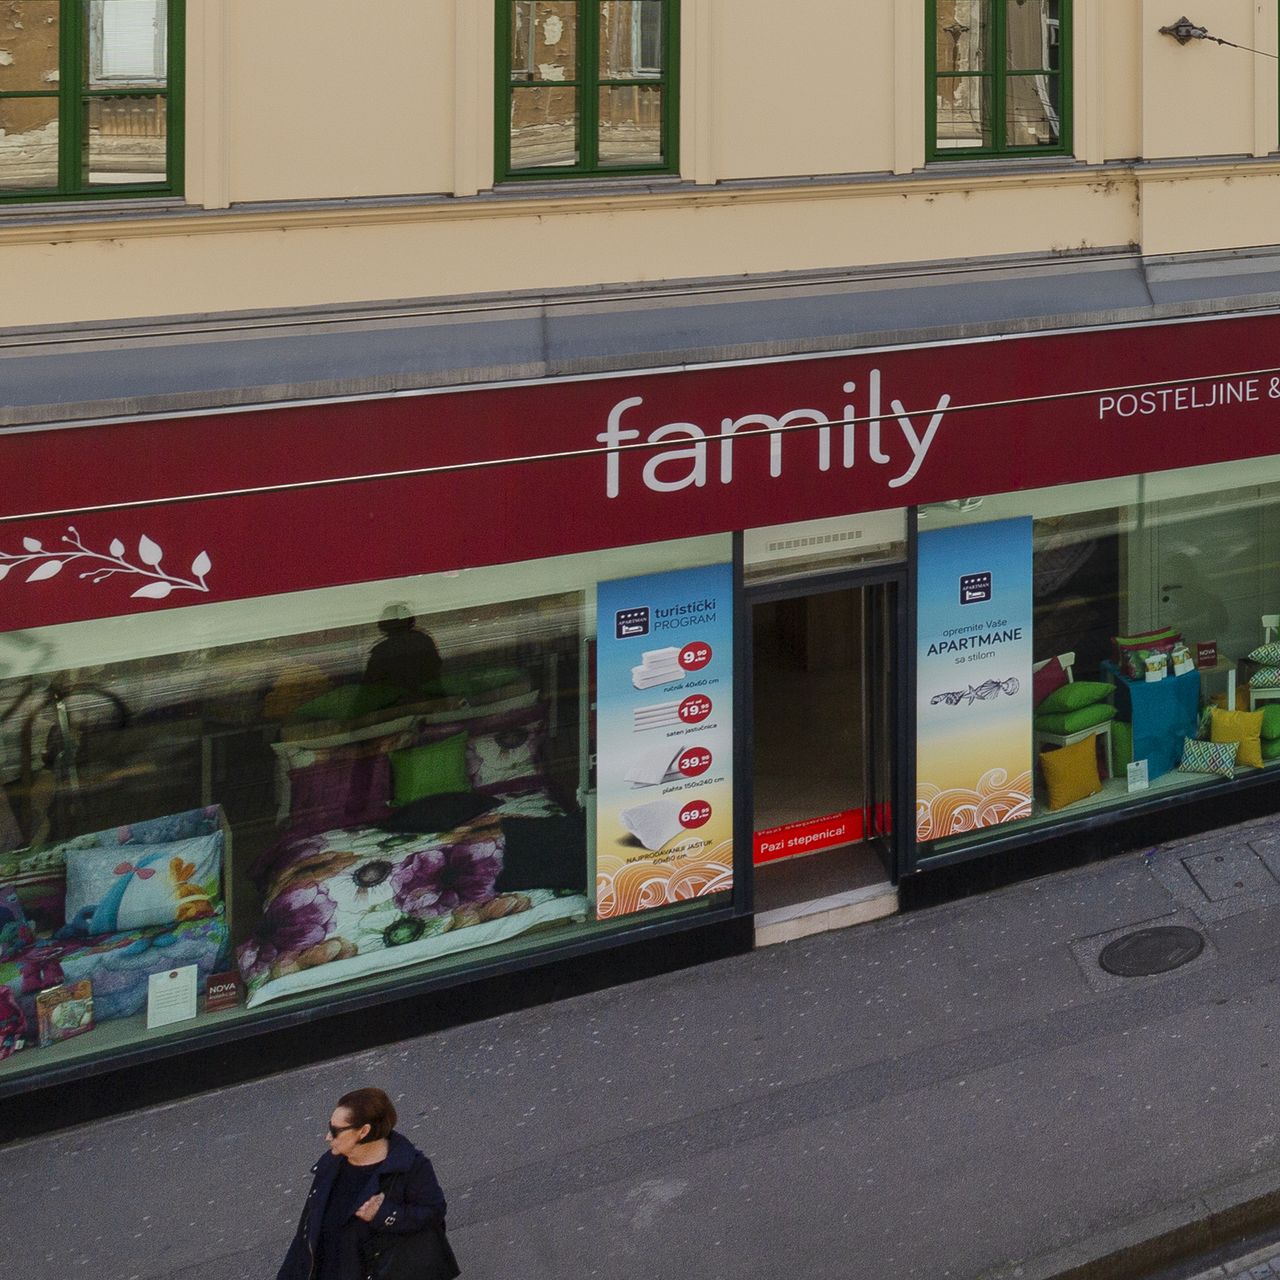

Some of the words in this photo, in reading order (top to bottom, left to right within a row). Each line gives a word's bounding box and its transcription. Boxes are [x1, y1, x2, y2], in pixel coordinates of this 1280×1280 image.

[1099, 379, 1260, 420] POSTELJINE
[596, 368, 951, 499] family
[961, 582, 990, 591] APARTMAN
[655, 598, 716, 619] turistički
[653, 613, 717, 632] PROGRAM
[942, 623, 984, 638] opremite
[985, 618, 1008, 631] Vaše
[926, 627, 1023, 657] APARTMANE
[954, 655, 966, 665] sa
[967, 650, 996, 662] stilom
[708, 677, 720, 686] cm
[666, 728, 685, 738] saten
[662, 784, 683, 795] plahta
[684, 778, 713, 790] 150x240
[713, 776, 725, 784] cm
[686, 839, 713, 851] JASTUK
[760, 839, 785, 854] Pazi
[787, 824, 846, 848] stepenica!
[676, 852, 688, 862] cm
[209, 982, 236, 994] NOVA
